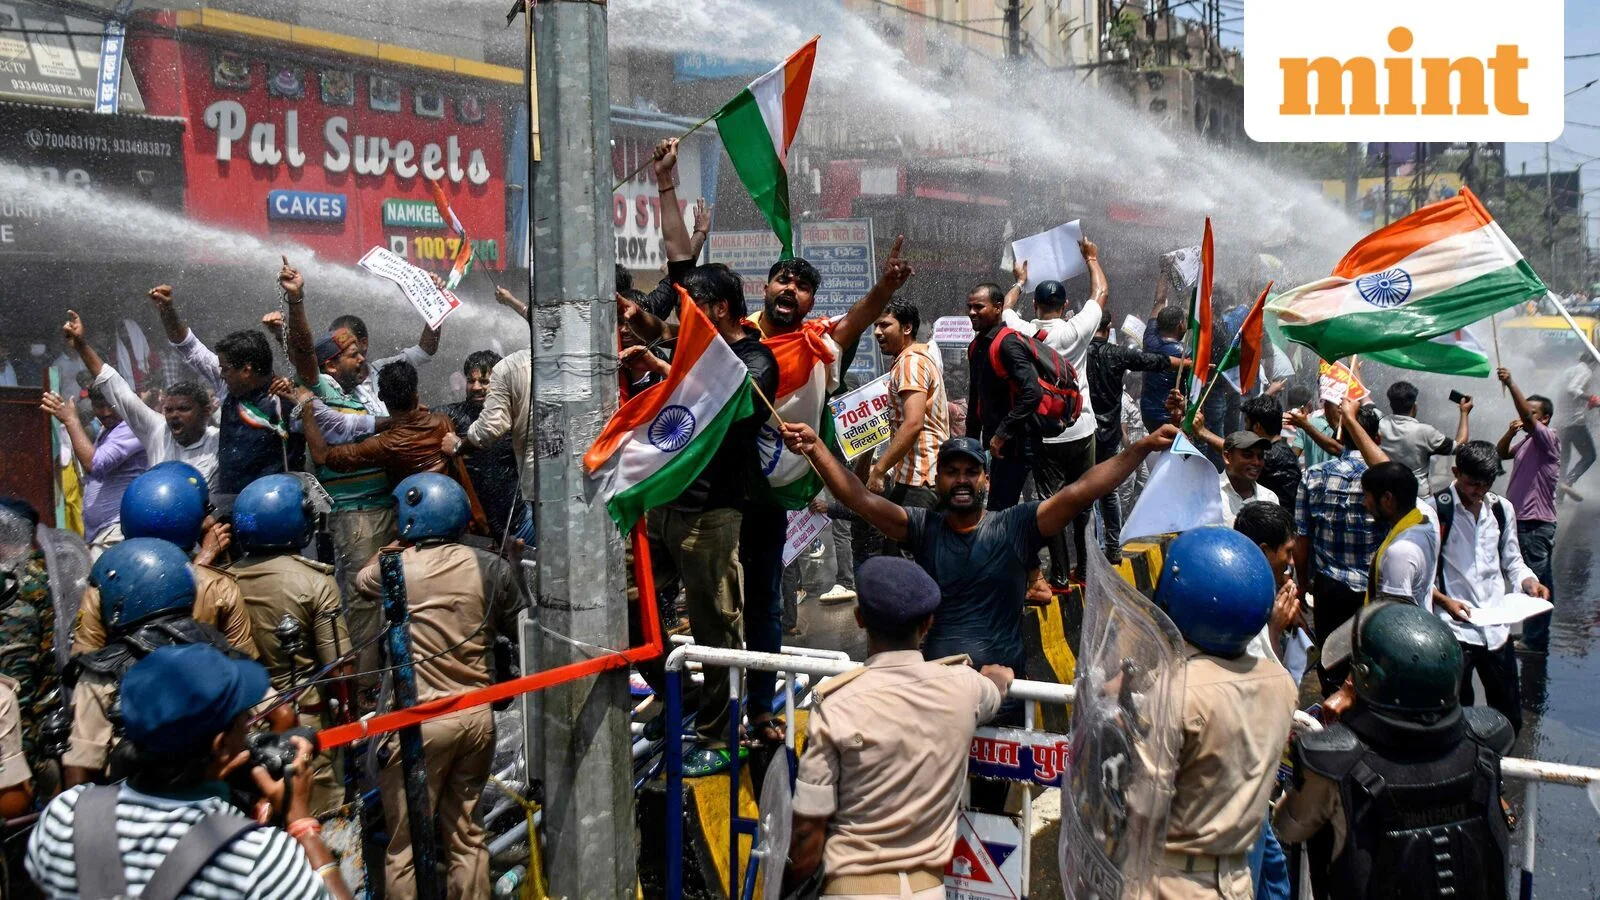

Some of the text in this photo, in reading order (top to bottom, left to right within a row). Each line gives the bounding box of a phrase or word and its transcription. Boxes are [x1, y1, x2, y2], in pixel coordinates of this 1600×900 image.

[204, 100, 490, 185] Pal Sweets
[275, 195, 342, 217] CAKES
[387, 203, 443, 224] NAMKEE
[711, 235, 742, 249] MONIKA
[744, 234, 771, 248] PHOTO
[838, 394, 888, 428] 70वीं BP
[843, 422, 869, 440] परीक्षा
[868, 415, 881, 428] को
[850, 425, 891, 450] निरस्त कि
[969, 736, 1021, 767] यात
